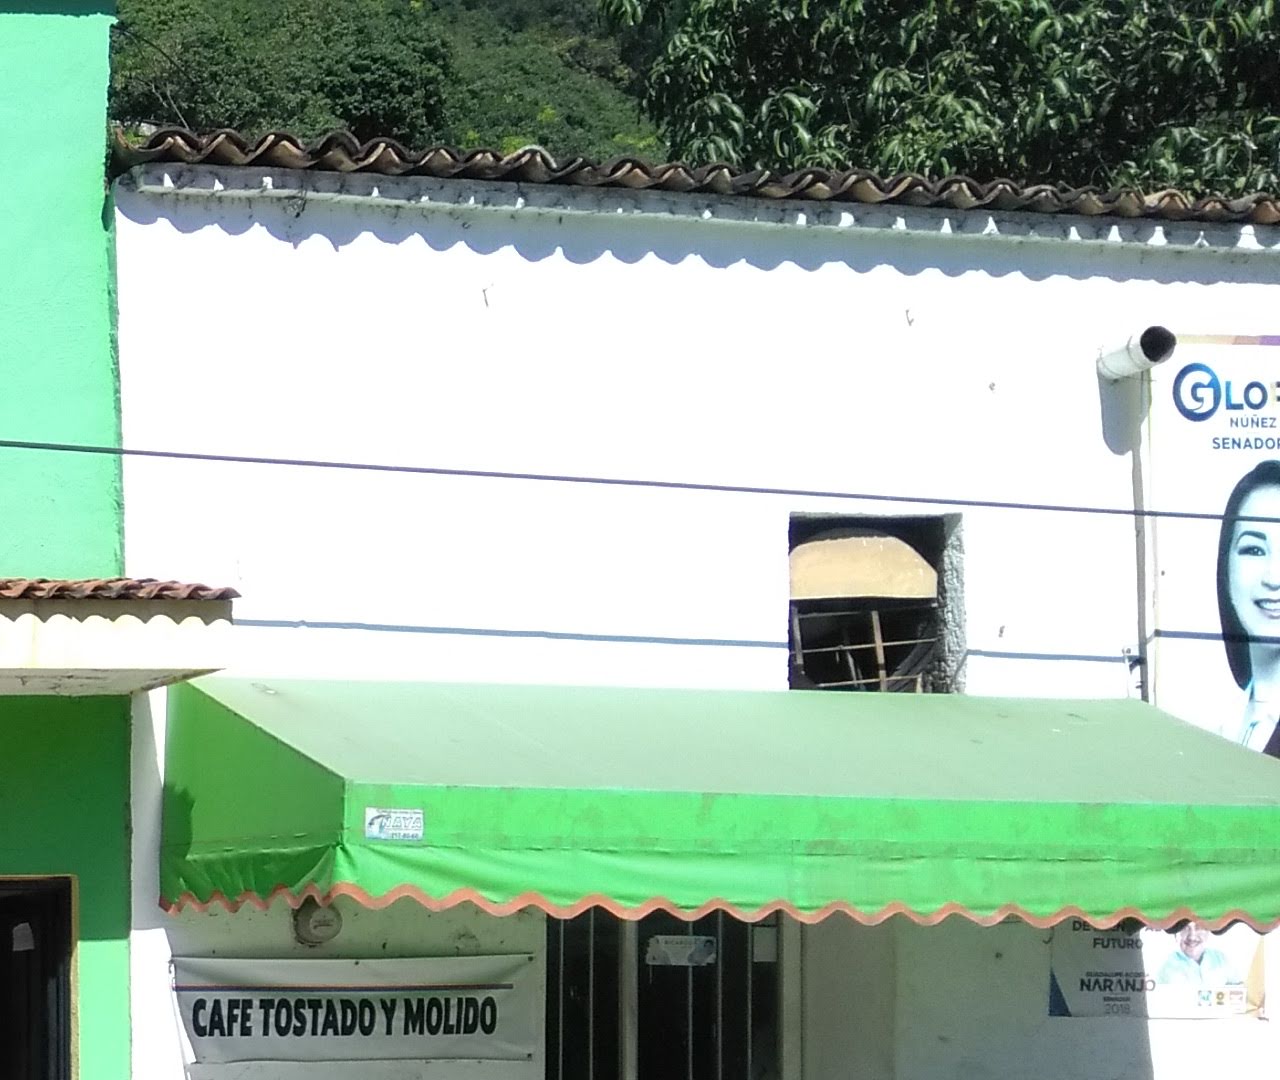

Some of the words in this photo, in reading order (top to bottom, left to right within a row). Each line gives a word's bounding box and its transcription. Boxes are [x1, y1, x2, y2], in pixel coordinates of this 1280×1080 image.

[1212, 437, 1280, 449] SENADO
[1093, 938, 1144, 949] FUTURO
[1080, 978, 1156, 992] NARANJO
[193, 999, 252, 1037] CAFE
[259, 997, 376, 1037] TOSTADO
[381, 998, 401, 1036] Y
[403, 996, 498, 1036] MOLIDO
